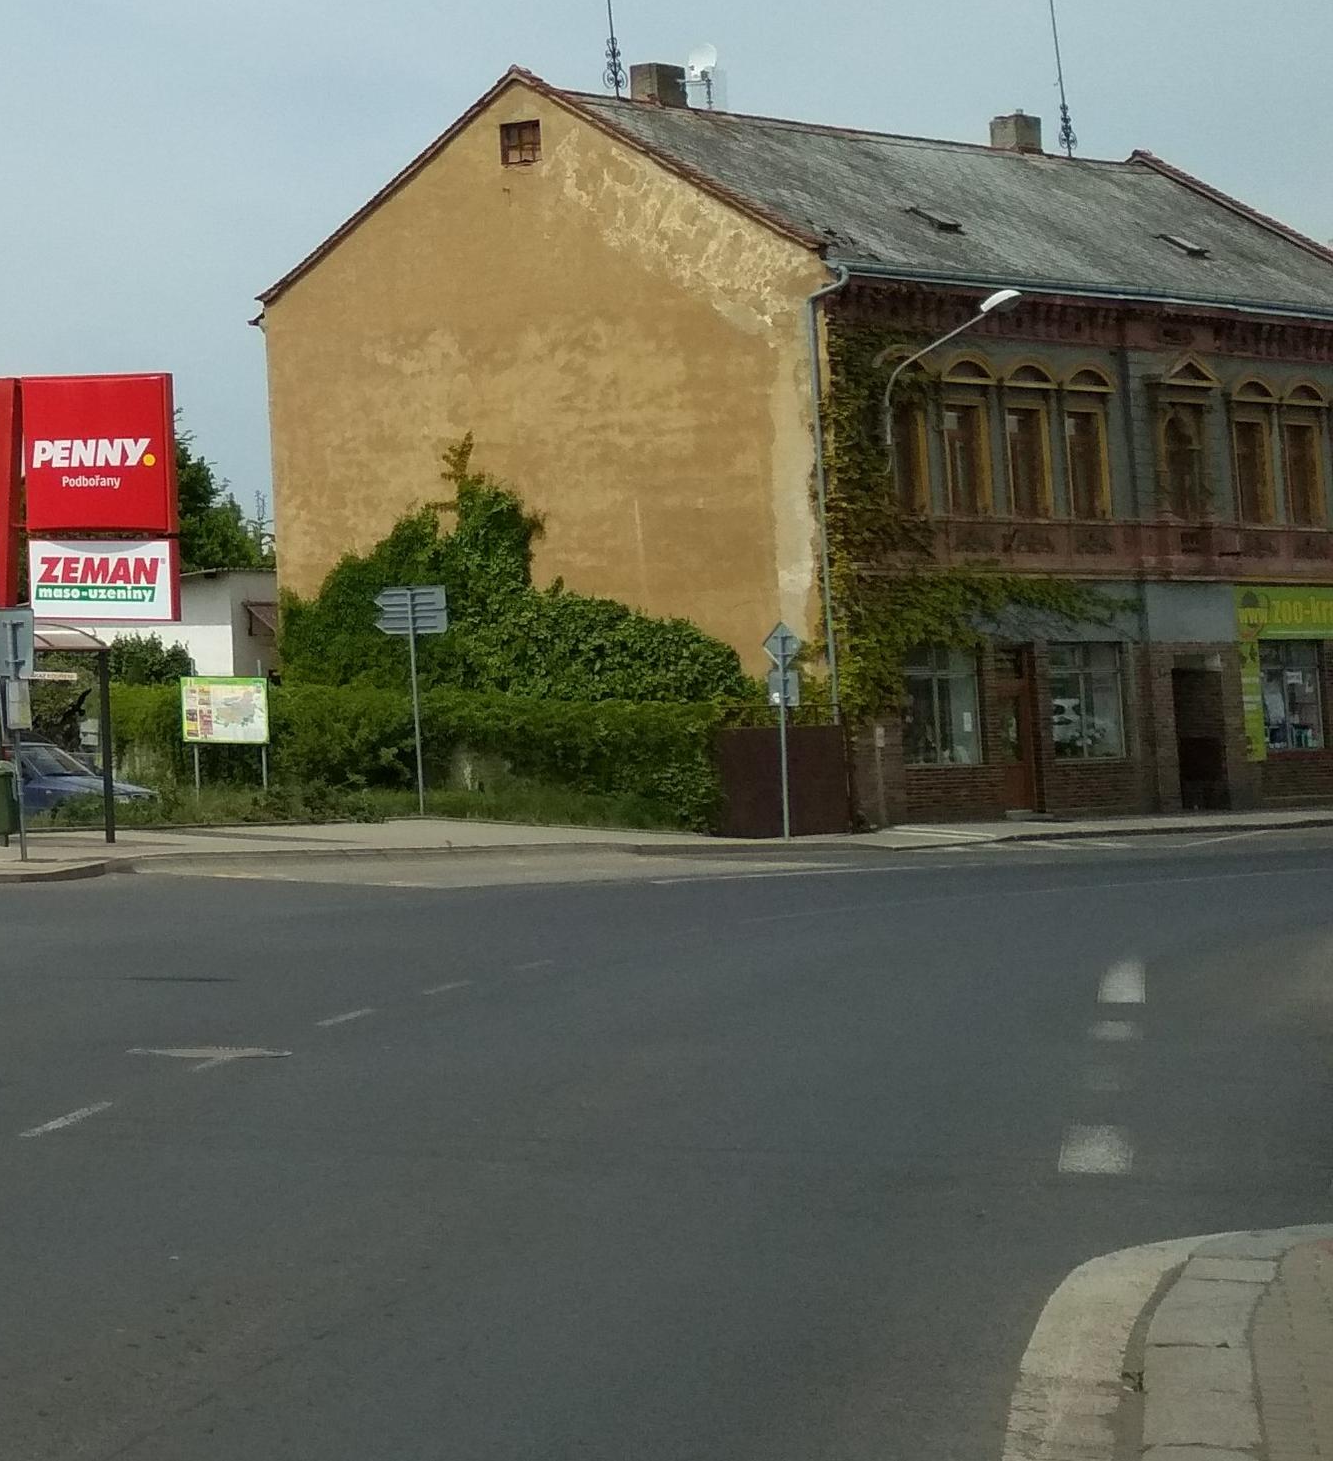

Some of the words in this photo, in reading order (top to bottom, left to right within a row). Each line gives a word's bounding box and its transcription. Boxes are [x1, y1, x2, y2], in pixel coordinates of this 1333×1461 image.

[62, 474, 121, 489] Podbořany
[38, 556, 159, 585] ZEMAN
[38, 585, 154, 601] maso-uzeniny
